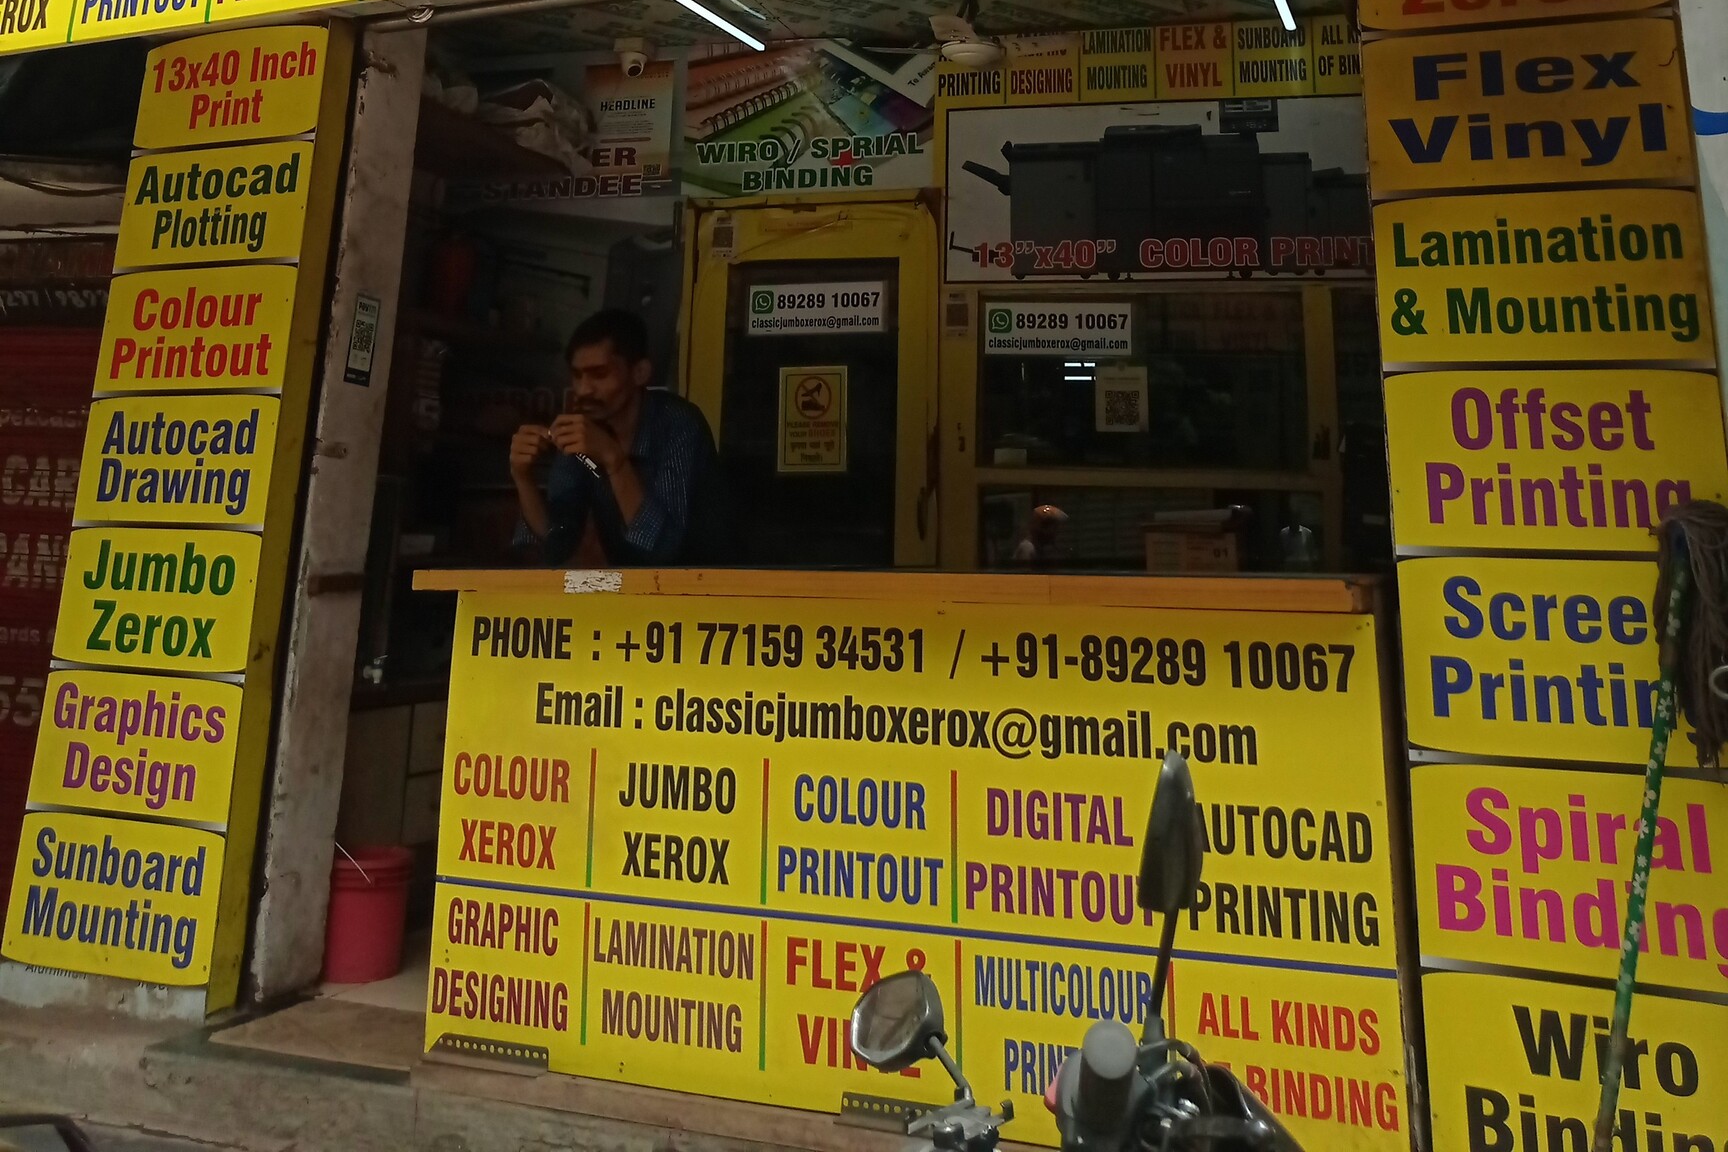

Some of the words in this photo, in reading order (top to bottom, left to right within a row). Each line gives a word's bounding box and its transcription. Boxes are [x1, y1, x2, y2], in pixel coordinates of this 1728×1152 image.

[1159, 26, 1206, 51] FLEX
[1321, 25, 1344, 46] ALL
[152, 49, 240, 93] 13x40
[250, 42, 316, 83] Inch
[938, 70, 1001, 97] PRINTING
[1010, 68, 1073, 95] DESIGNING
[1087, 63, 1148, 89] MOUNTING
[1165, 62, 1223, 89] VINYL
[1239, 58, 1307, 84] MOUNTING
[1318, 56, 1335, 76] OF
[1412, 49, 1642, 101] Flex
[188, 89, 263, 129] Print
[600, 97, 656, 112] HEADLINE
[696, 142, 790, 166] WIRO
[811, 132, 924, 163] SPRIAL
[1388, 103, 1669, 167] Vinyl
[134, 152, 301, 205] Autocad
[742, 165, 874, 193] BINDING
[151, 204, 268, 253] Plotting
[1138, 237, 1258, 268] COLOR
[1392, 213, 1684, 268] Lamination
[133, 287, 263, 331] Colour
[751, 314, 880, 330] classicjumboxerox@gmail.com
[777, 291, 826, 311] 89289
[831, 289, 880, 309] 10067
[1015, 312, 1070, 331] 89289
[1074, 312, 1128, 331] 10067
[1391, 288, 1428, 337] &
[1446, 283, 1700, 343] Mounting
[109, 334, 272, 380] Printout
[988, 336, 1128, 353] classicjumboxerox@gmail.com
[101, 408, 260, 455] Autocad
[1451, 387, 1655, 451] Offset
[95, 453, 251, 516] Drawing
[83, 539, 238, 597] Jumbo
[85, 599, 217, 659] Zerox
[471, 616, 573, 661] PHONE
[616, 621, 683, 664] +91
[697, 623, 802, 667] 77159
[815, 625, 923, 673] 34531
[949, 629, 965, 679] /
[981, 633, 1206, 687] +91-89289
[1223, 641, 1356, 693] 10067
[53, 682, 227, 746] Graphics
[536, 682, 624, 729] Email
[655, 688, 1258, 766] classicjumboxerox@gmail.com
[62, 741, 196, 810] Design
[453, 751, 570, 803] COLOUR
[619, 761, 737, 815] JUMBO
[793, 773, 926, 831] COLOUR
[986, 786, 1135, 847] DIGITAL
[1465, 786, 1713, 875] Spiral
[32, 826, 207, 898] Sunboard
[458, 818, 557, 871] XEROX
[621, 830, 731, 885] XEROX
[777, 845, 944, 907] PRINTOUT
[21, 884, 198, 970] Mounting
[448, 896, 560, 957] GRAPHIC
[1188, 880, 1381, 948] PRINTING
[593, 916, 755, 981] LAMINATION
[786, 936, 887, 994] FLEX
[431, 966, 569, 1033] DESIGNING
[601, 988, 743, 1054] MOUNTING
[1197, 992, 1260, 1042] ALL
[1271, 998, 1382, 1056] KINDS
